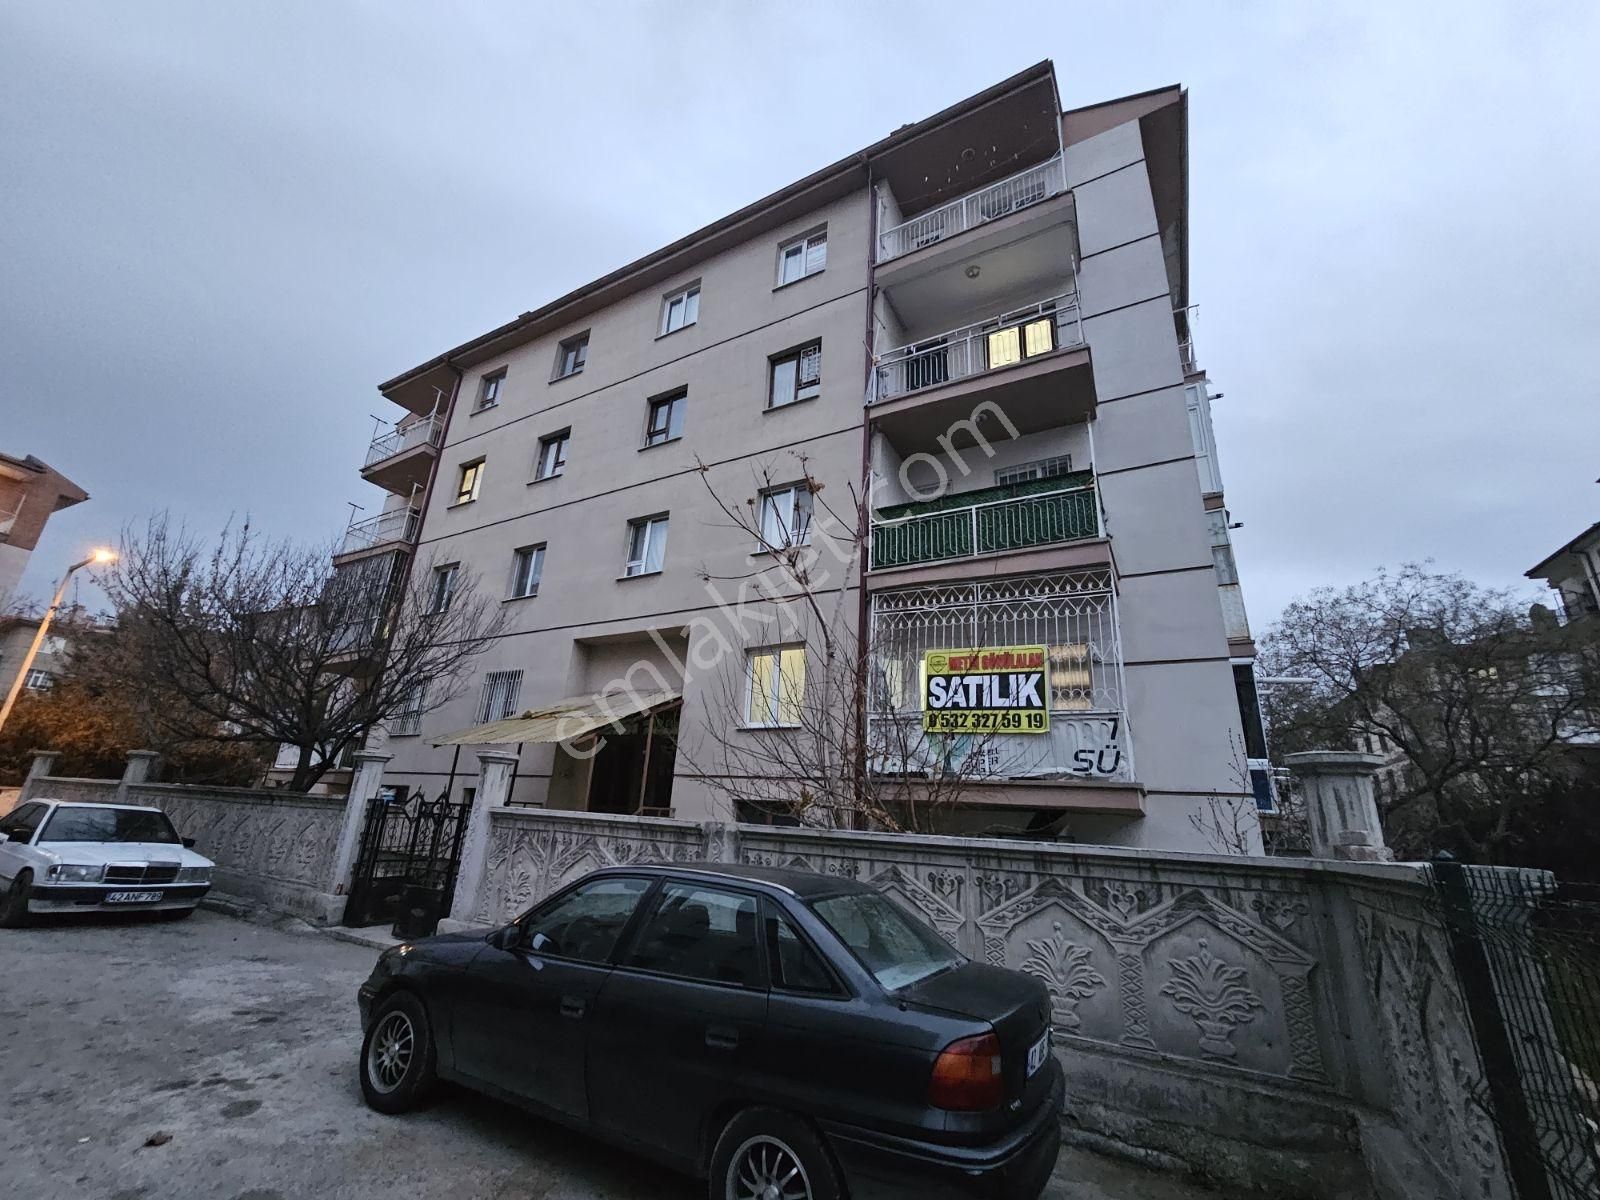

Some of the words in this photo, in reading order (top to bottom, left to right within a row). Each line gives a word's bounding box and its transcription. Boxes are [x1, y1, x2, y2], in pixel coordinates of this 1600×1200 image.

[928, 673, 1043, 708] SATILIK
[940, 714, 968, 728] 532
[971, 714, 998, 728] 327
[1001, 713, 1021, 728] 59
[1025, 713, 1044, 728] 19
